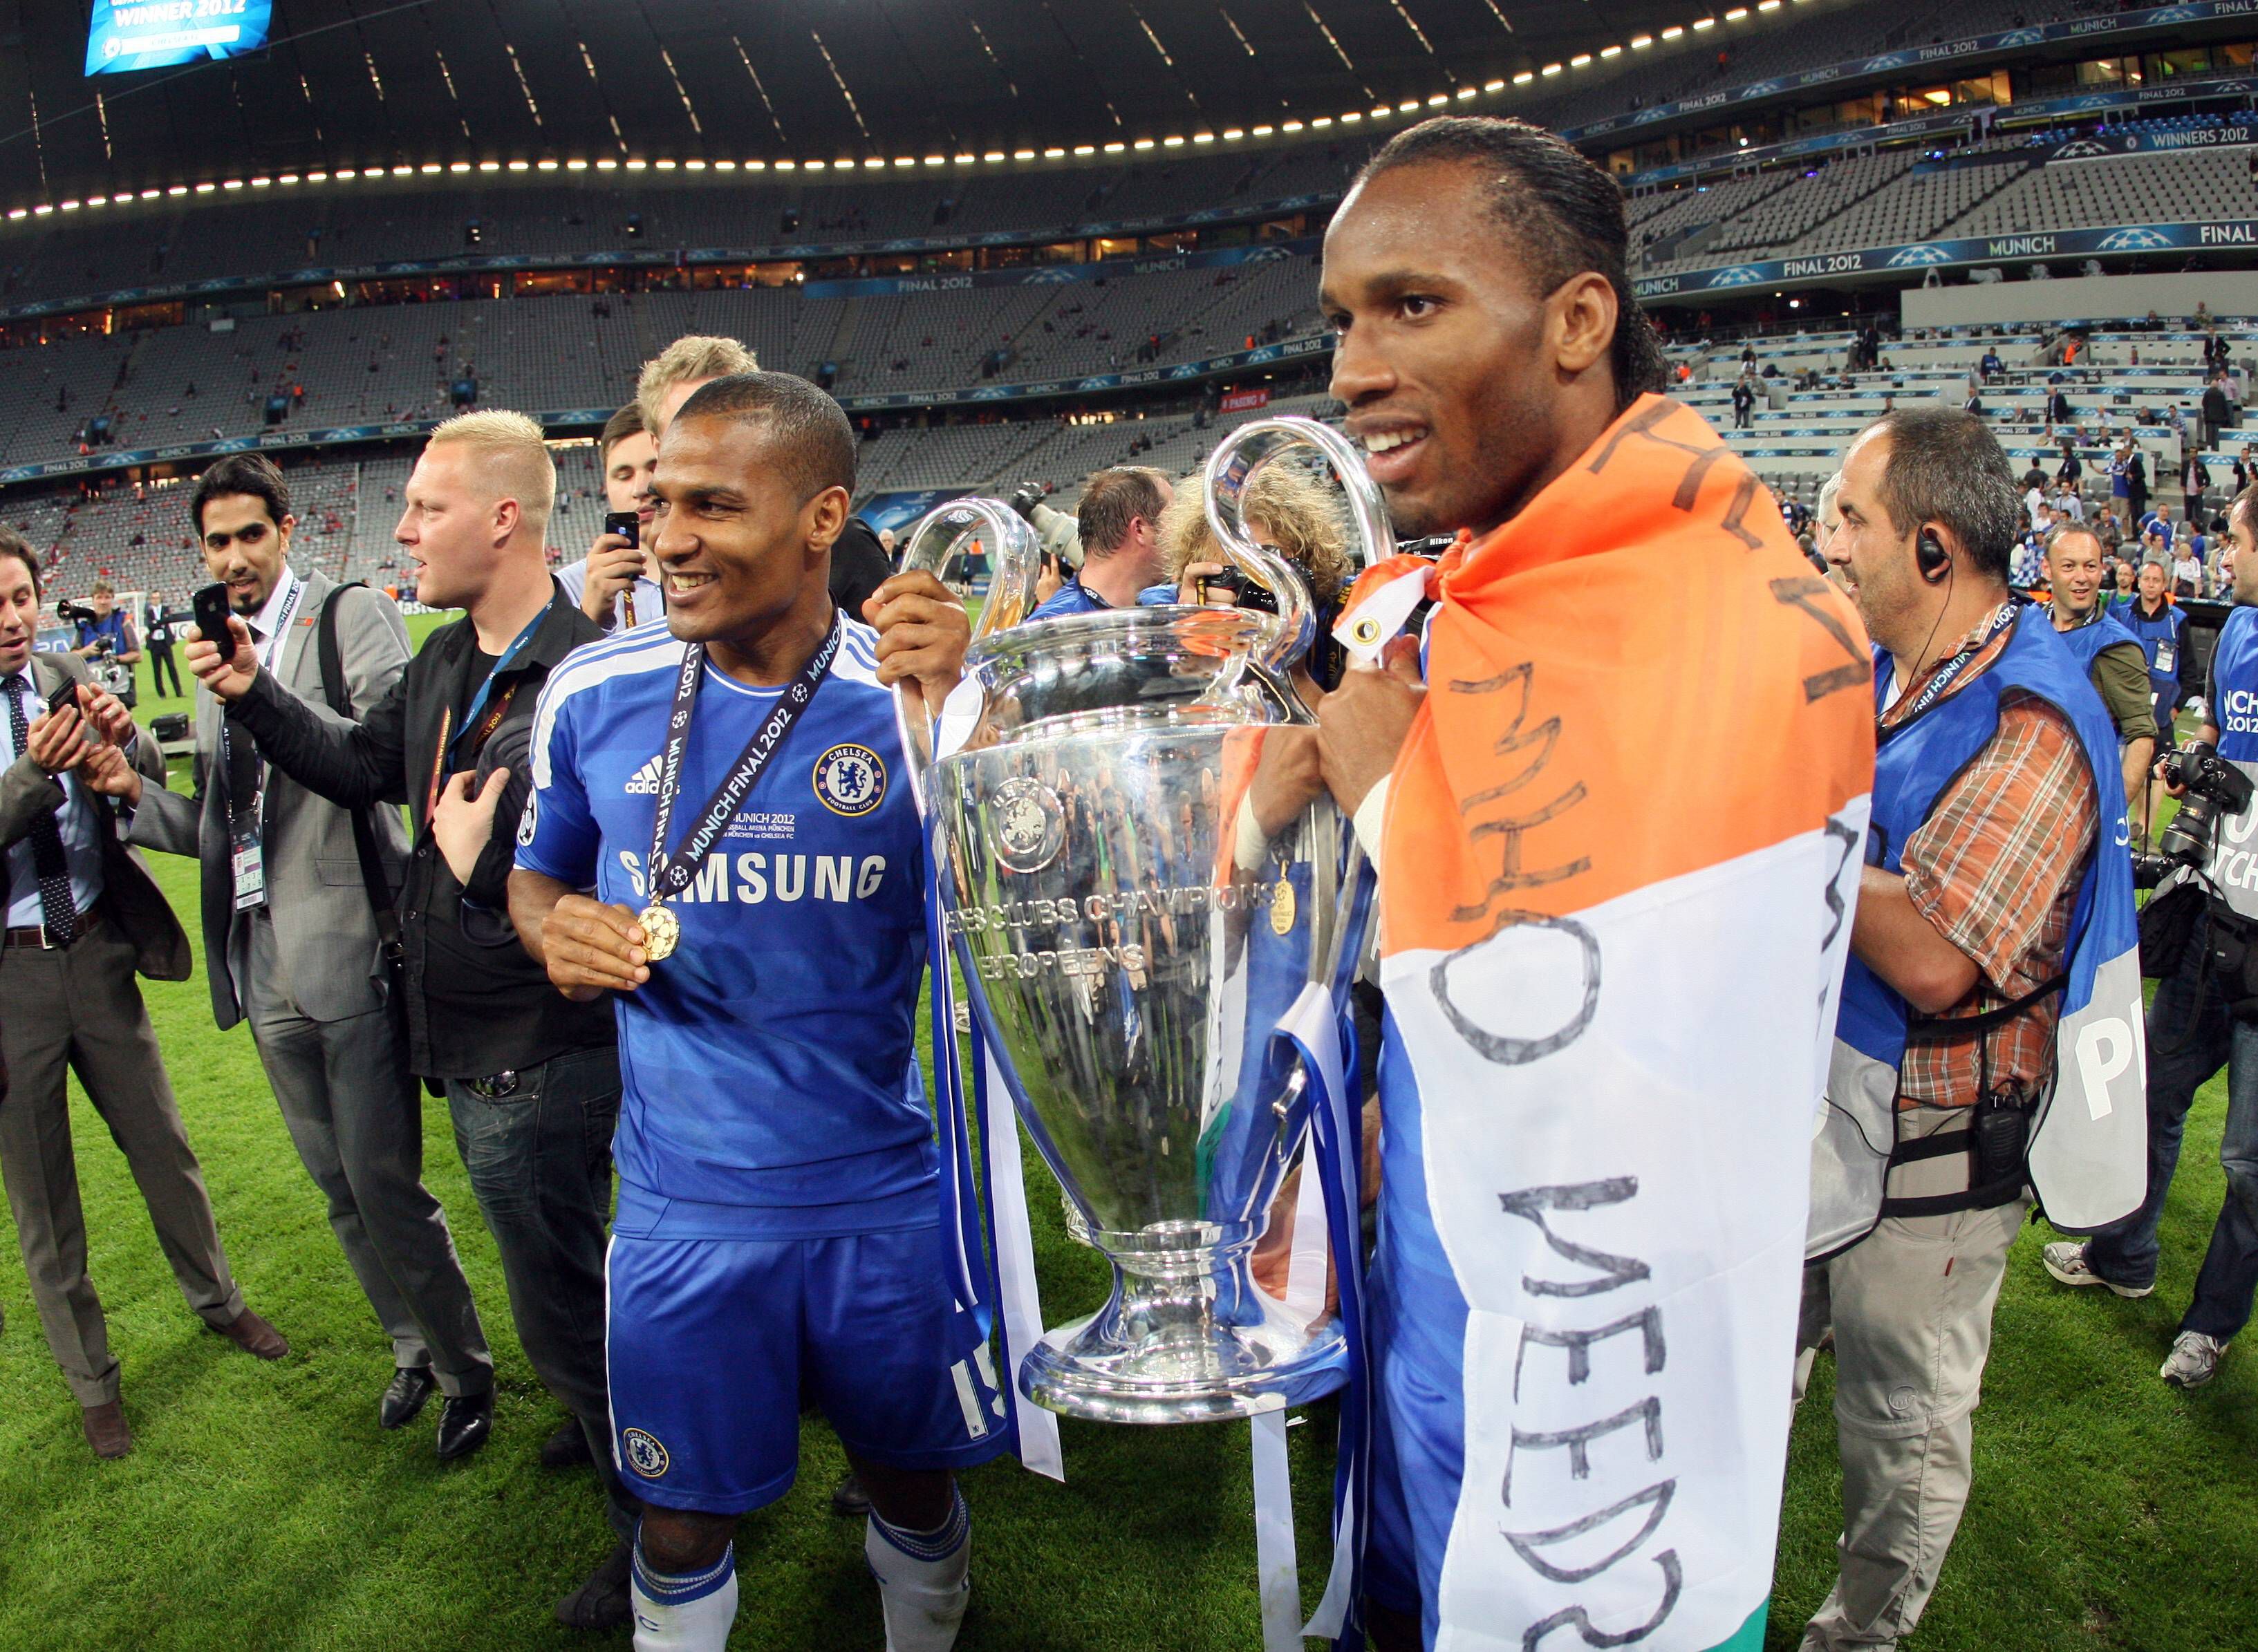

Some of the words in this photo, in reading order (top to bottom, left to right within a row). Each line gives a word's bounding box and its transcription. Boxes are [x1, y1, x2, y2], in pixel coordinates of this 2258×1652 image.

[115, 2, 193, 28] WINNER
[196, 0, 245, 17] 2012
[2214, 1, 2252, 15] FINAL
[2070, 18, 2117, 34] MUNICH
[1920, 46, 1951, 60] FINAL
[1952, 41, 1979, 54] 2012
[1800, 68, 1839, 84] MUNICH
[1679, 98, 1704, 112] FINAL
[1705, 93, 1726, 106] 2012
[2139, 91, 2164, 101] FINAL
[2165, 88, 2185, 97] 2012
[1887, 124, 1908, 135] FINAL
[1910, 122, 1927, 131] 2012
[2152, 130, 2217, 148] WINNERS
[2219, 127, 2249, 142] 2012
[2200, 225, 2256, 243] FINAL
[1988, 236, 2056, 256] MUNICH
[1134, 258, 1186, 274] MUNICH
[1784, 261, 1826, 277] FINAL
[1827, 254, 1863, 272] 2012
[899, 279, 935, 293] FINAL
[940, 276, 973, 290] 2012
[1633, 278, 1679, 297] MUNICH
[1283, 344, 1303, 356] FINAL
[1303, 339, 1322, 352] 2012
[908, 394, 935, 403] FINAL
[936, 392, 958, 402] 2012
[260, 435, 286, 447] FINAL
[287, 433, 310, 444] 2012
[44, 460, 68, 473] FINAL
[68, 459, 89, 471] 2012
[1430, 537, 1454, 546] Nikon
[806, 619, 842, 682] MUNICH
[675, 659, 698, 702] 2012
[2226, 715, 2258, 734] 2012
[828, 748, 873, 765] CHELSEA
[659, 737, 683, 809] MUNICH
[685, 791, 736, 863] MUNICH
[728, 747, 769, 798] FINAL
[759, 707, 793, 751] 2012
[827, 796, 857, 811] FOOTBALL
[859, 799, 874, 810] CLUB
[771, 814, 795, 825] 2012
[651, 807, 673, 865] FINAL
[991, 897, 1081, 931] CLUBS
[1083, 883, 1276, 923] CHAMPIONS
